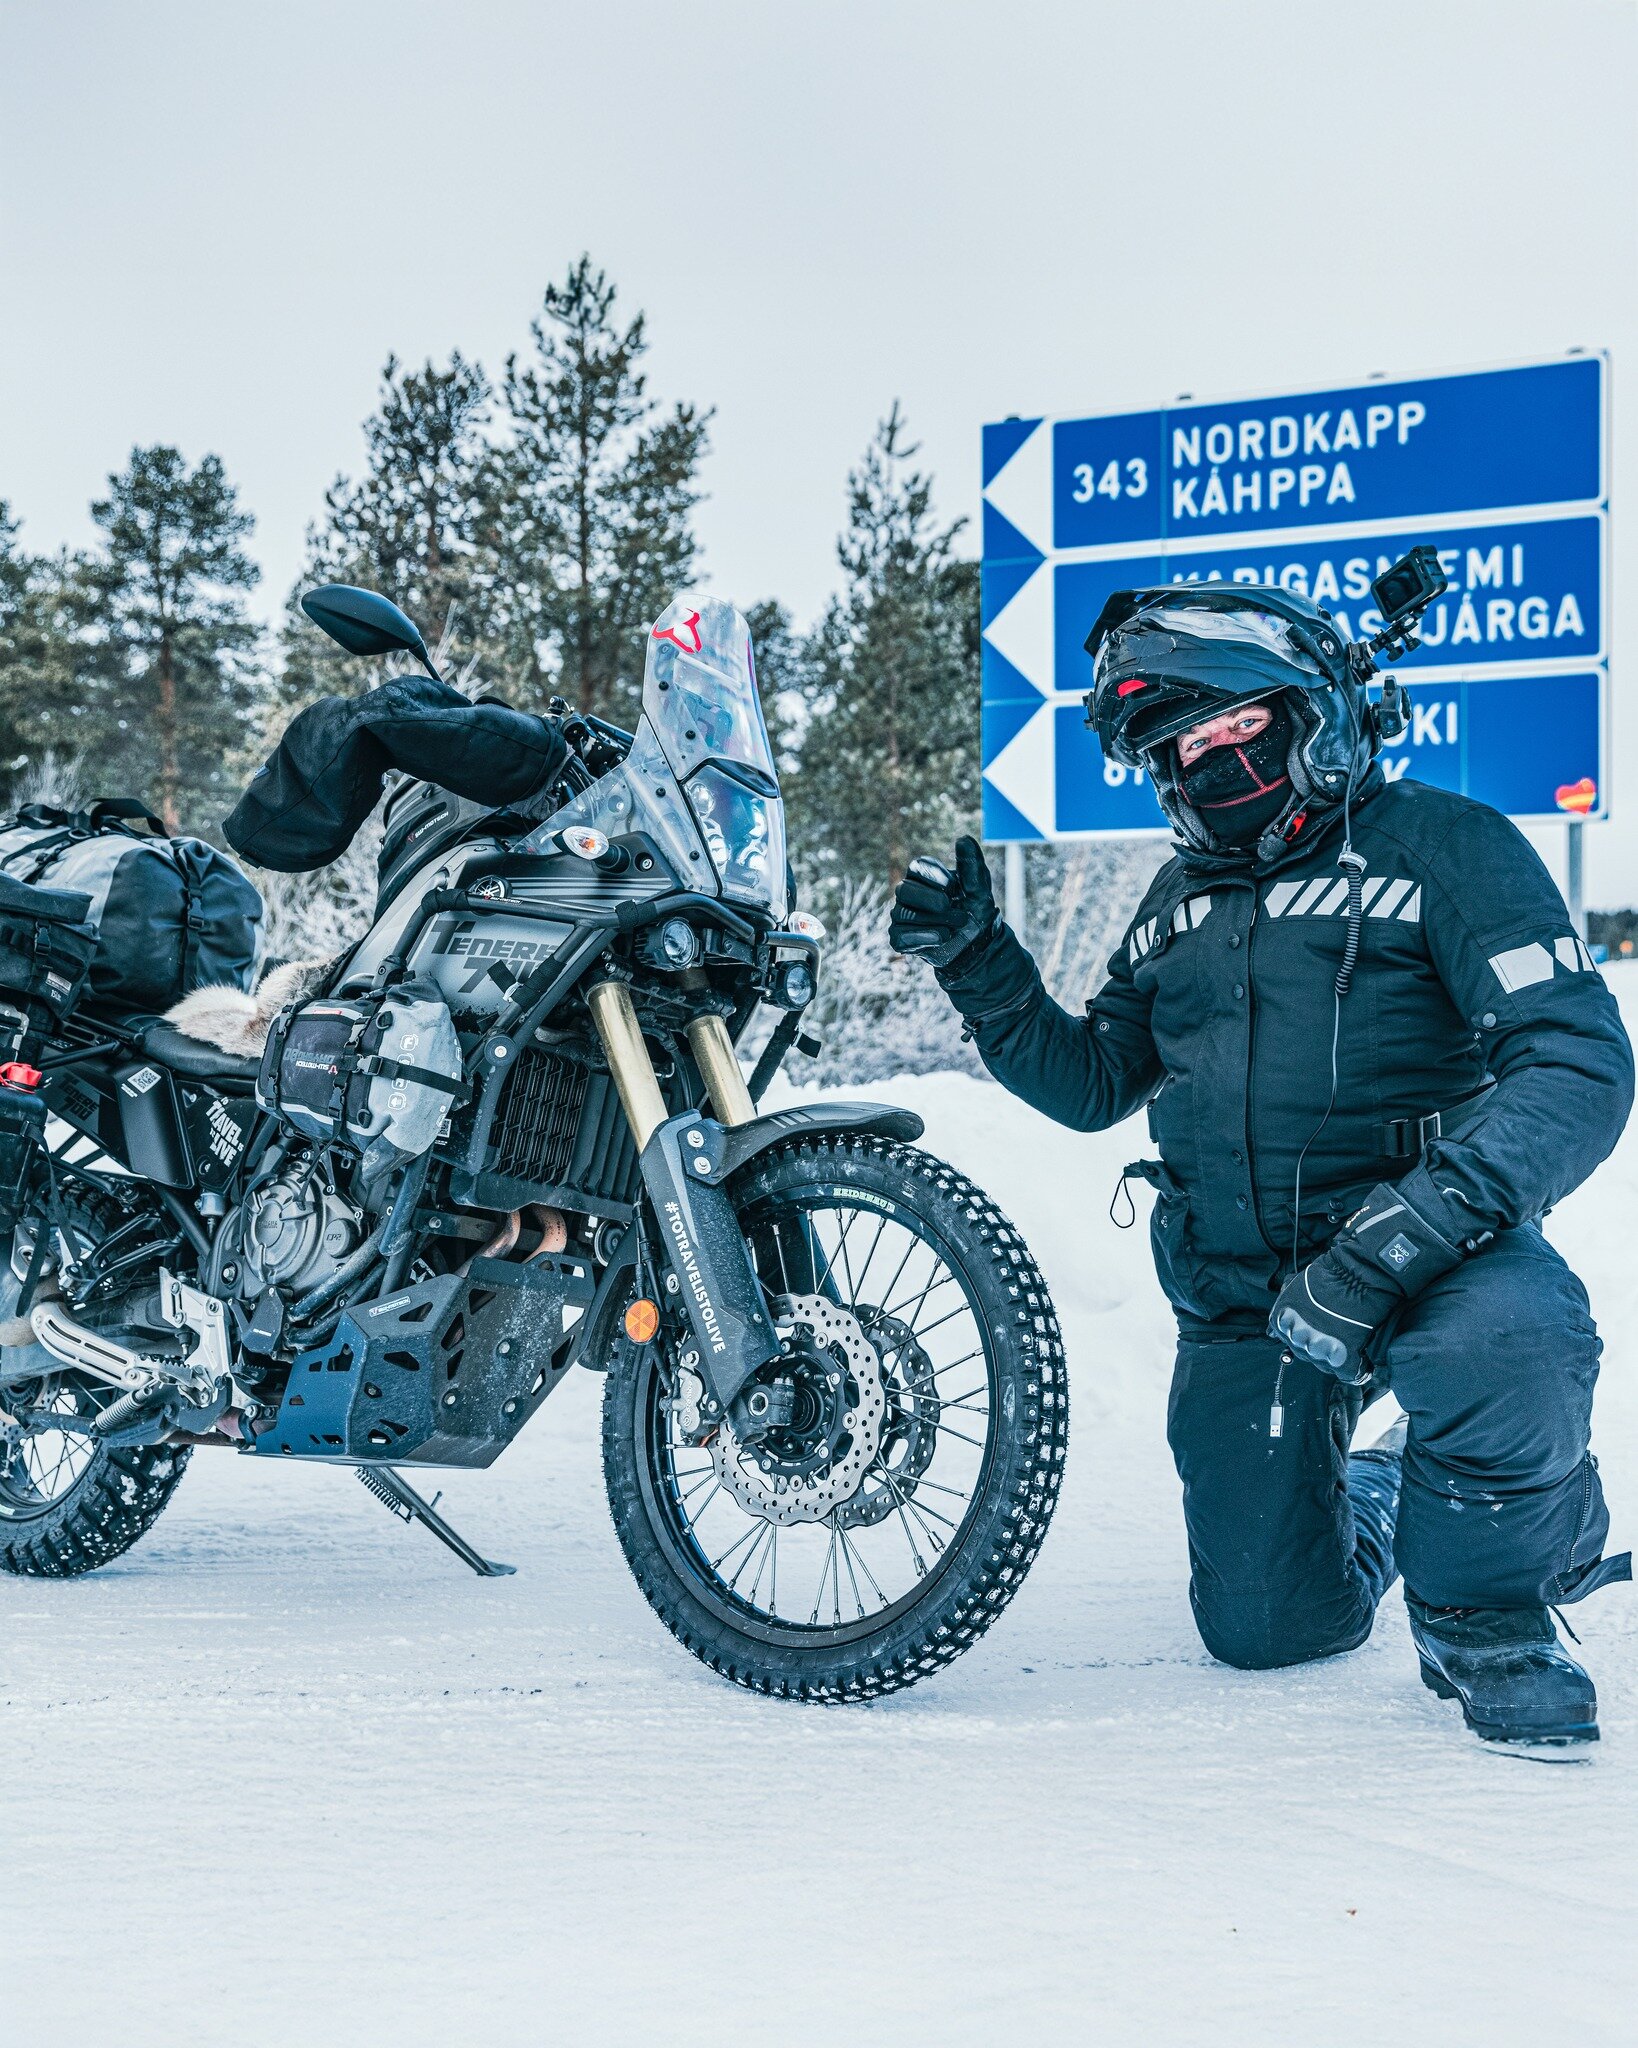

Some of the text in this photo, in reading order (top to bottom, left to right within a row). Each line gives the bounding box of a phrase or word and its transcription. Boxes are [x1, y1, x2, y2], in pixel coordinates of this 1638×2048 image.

[1172, 402, 1426, 469] NORDKAPP
[1072, 457, 1148, 503] 343
[1172, 461, 1356, 519] KÁHPPA
[205, 1100, 243, 1147] TRAVEL
[664, 1201, 727, 1354] #TOTRAVELISTOLIVE
